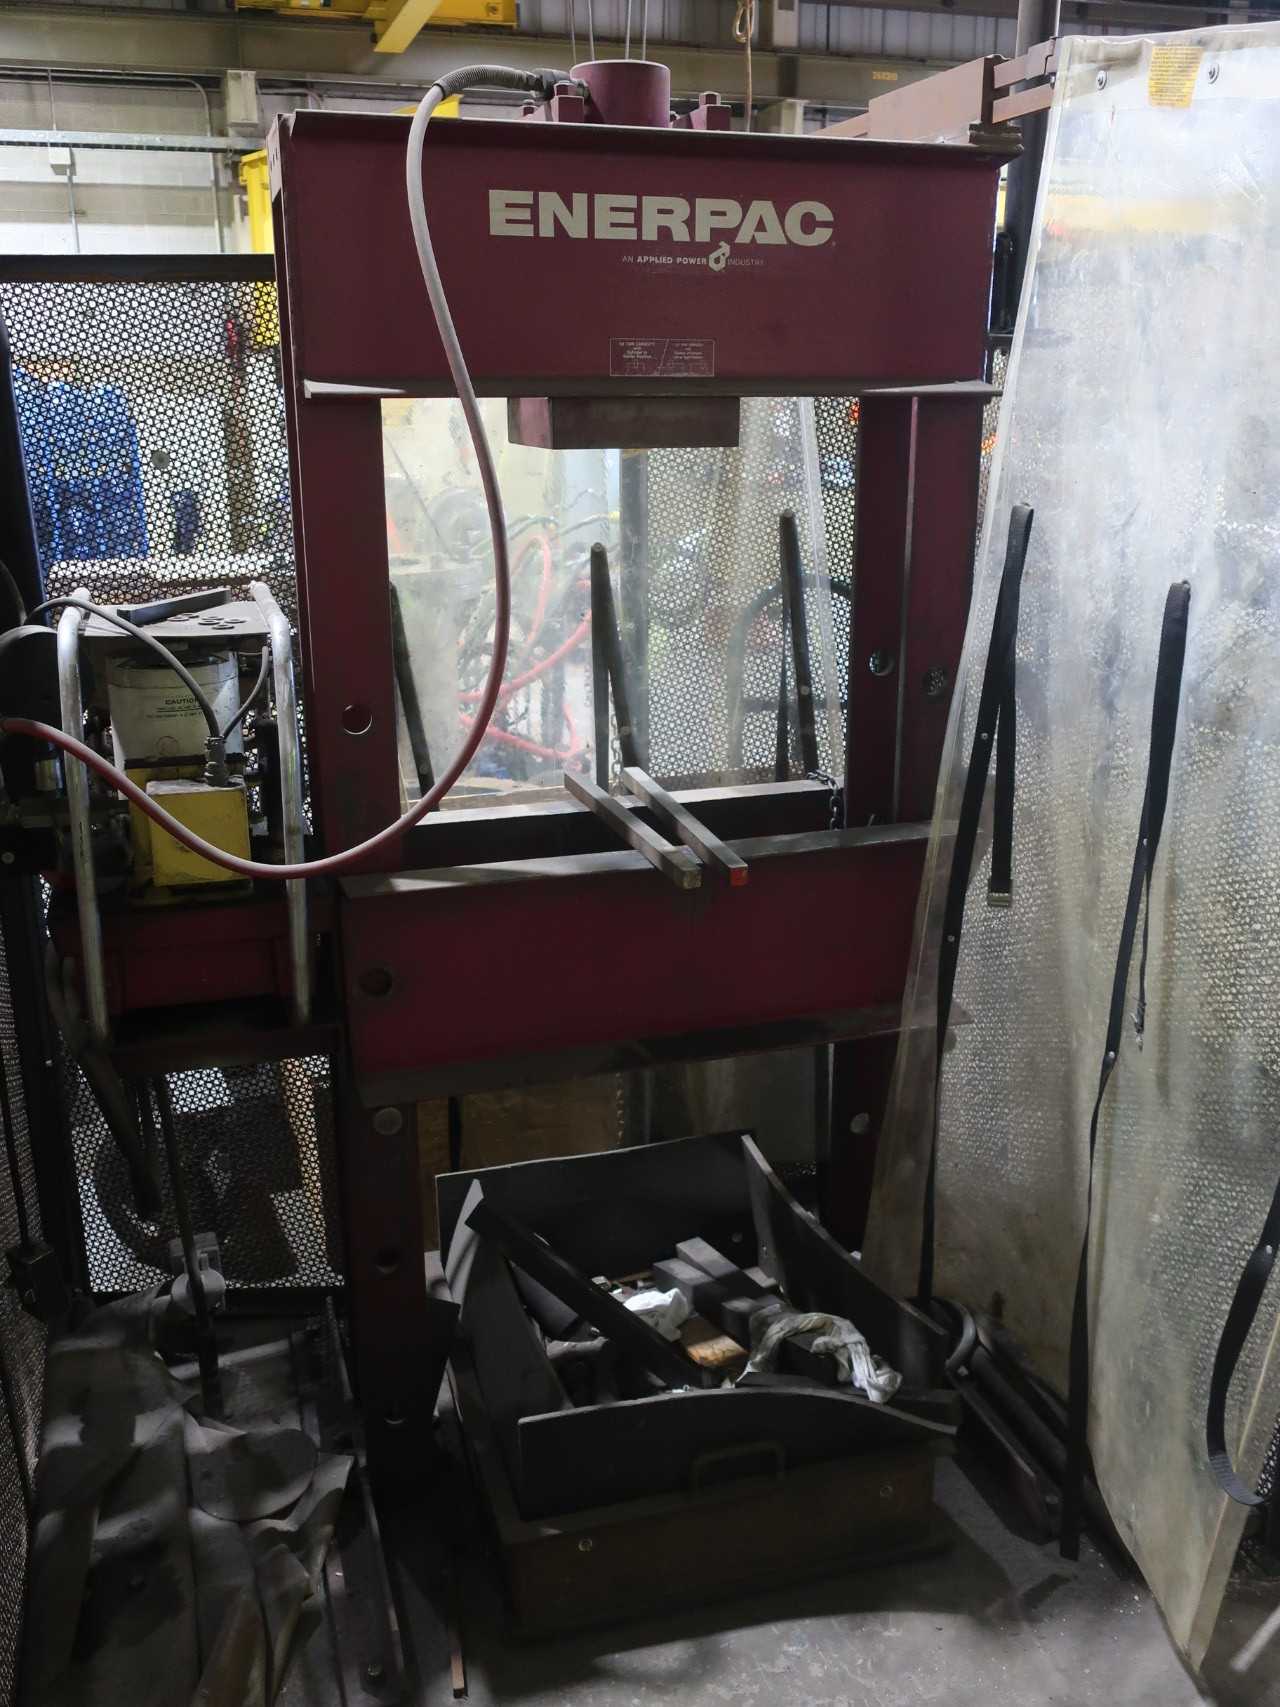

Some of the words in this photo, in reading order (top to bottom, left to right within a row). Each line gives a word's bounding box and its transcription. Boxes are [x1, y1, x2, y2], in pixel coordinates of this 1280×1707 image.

[489, 189, 834, 246] ENERPAC
[622, 256, 634, 264] AN
[637, 255, 673, 264] APPLIED
[676, 256, 707, 265] POWER
[727, 258, 764, 266] INDUSTRY
